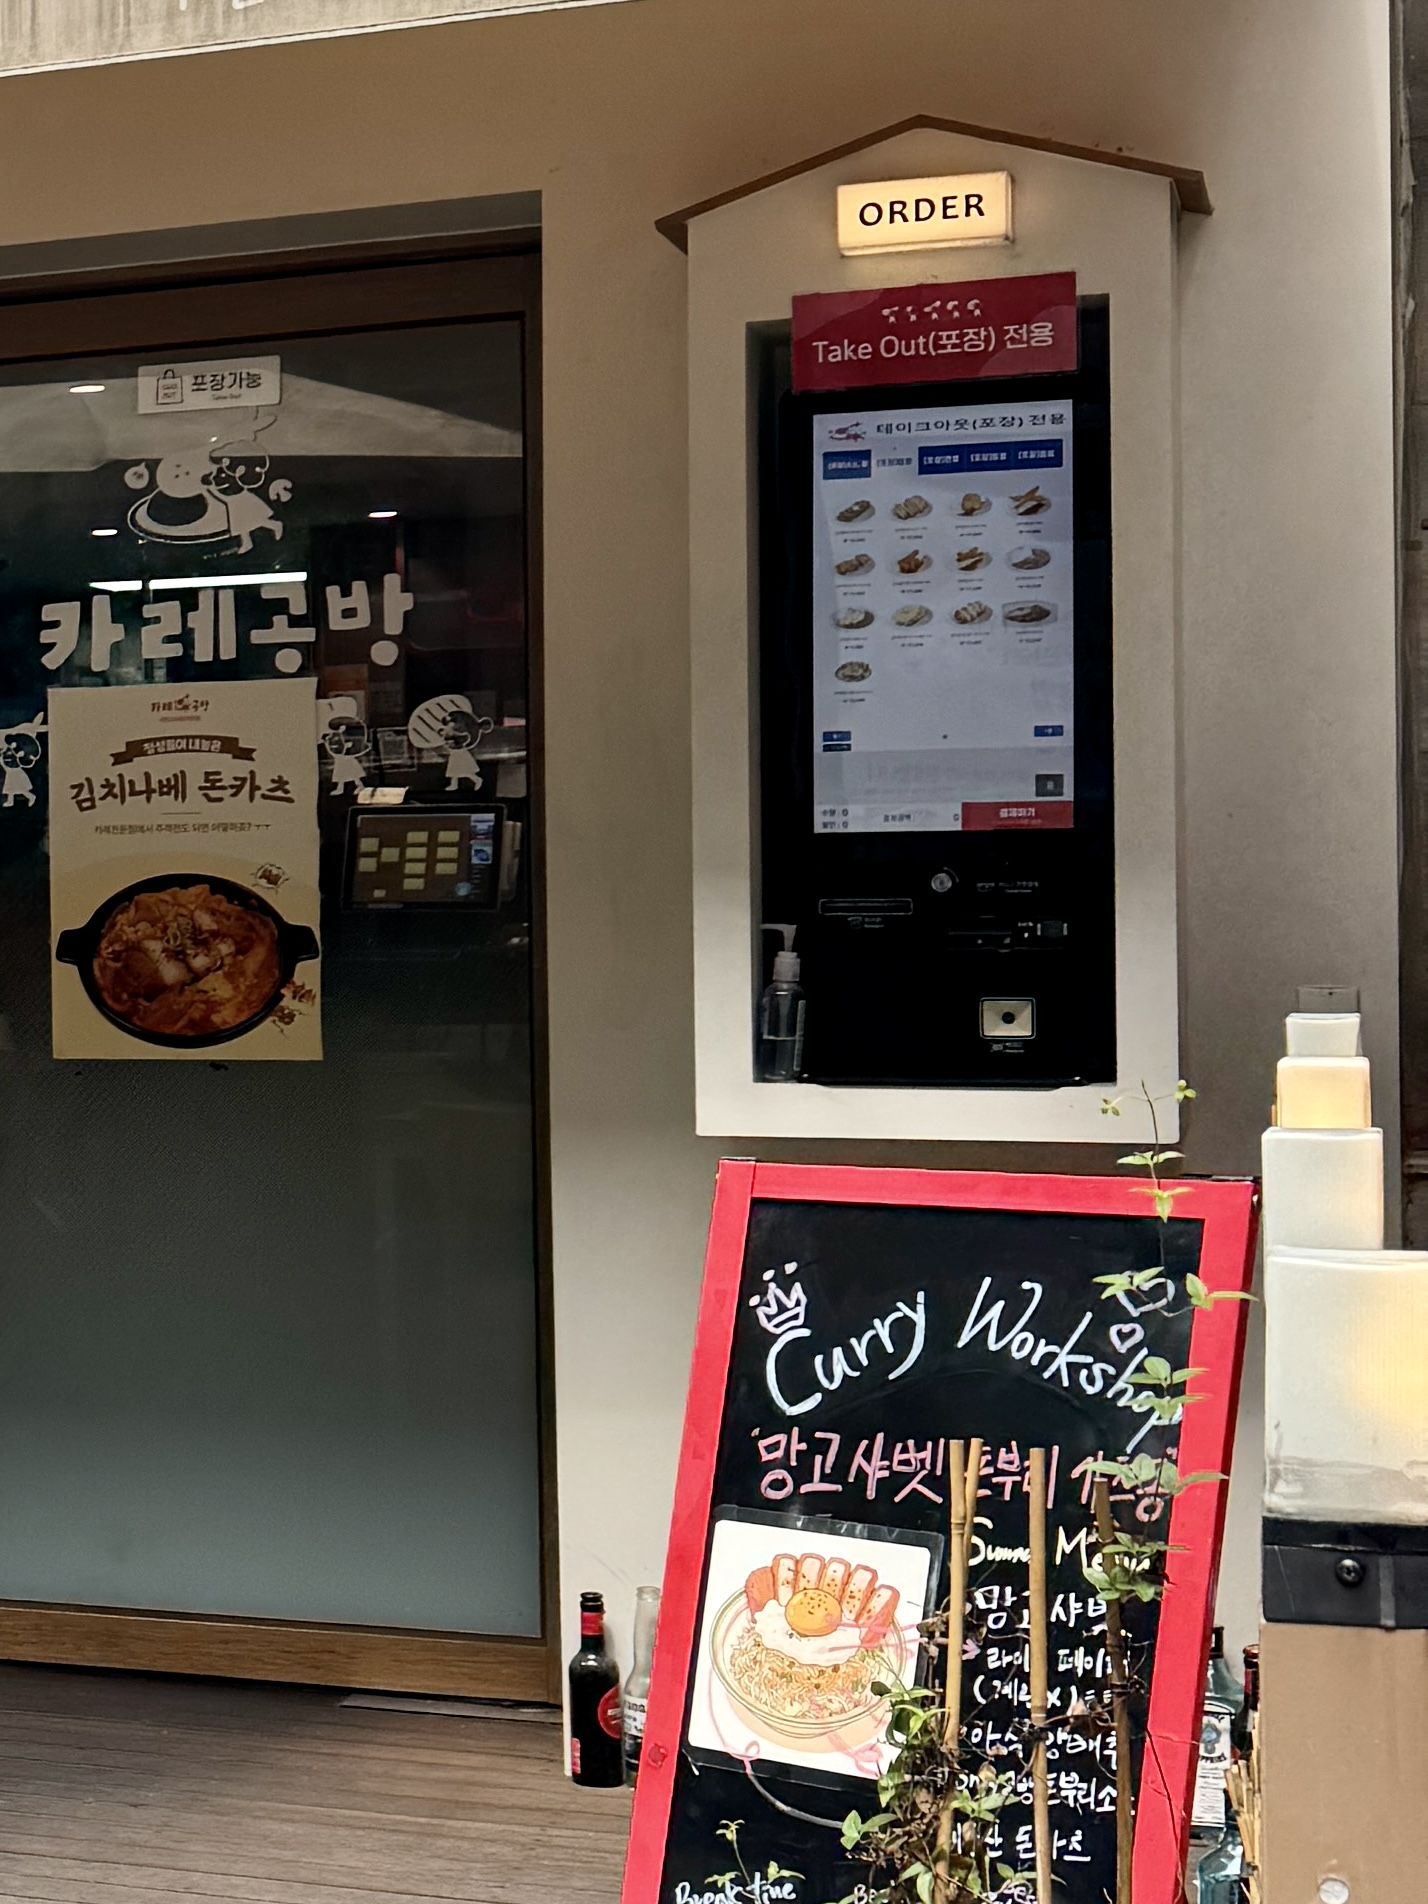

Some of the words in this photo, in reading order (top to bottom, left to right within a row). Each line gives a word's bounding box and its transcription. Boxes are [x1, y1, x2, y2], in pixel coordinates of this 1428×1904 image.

[858, 192, 986, 227] ORDER
[812, 338, 872, 364] Take
[879, 324, 997, 361] Out(포장)
[1003, 321, 1055, 349] 전용
[191, 369, 262, 393] 포장가능
[40, 573, 415, 673] 카레공방
[69, 769, 187, 813] 김치나베
[197, 769, 296, 805] 돈카츠
[765, 1290, 926, 1417] Curry
